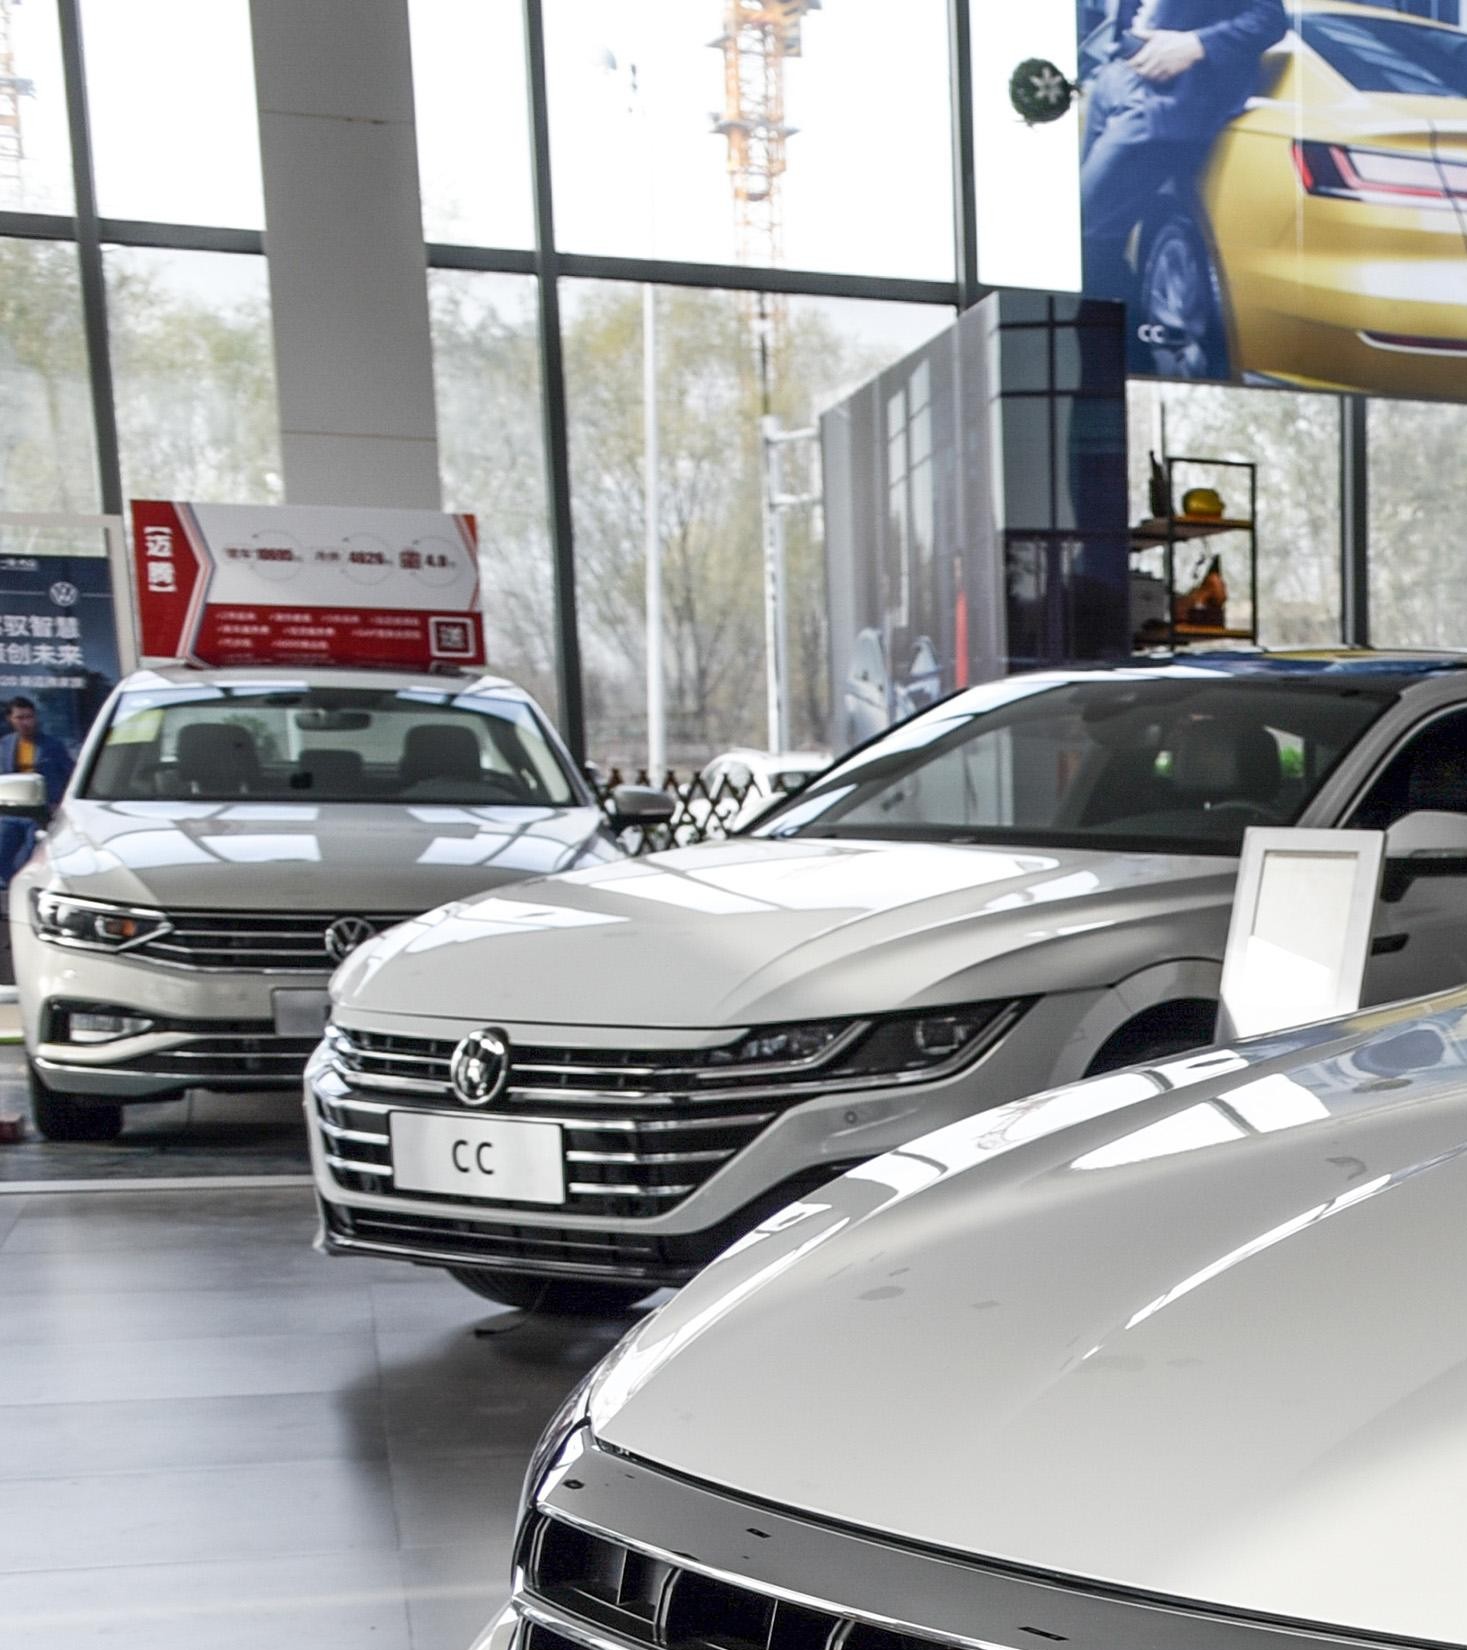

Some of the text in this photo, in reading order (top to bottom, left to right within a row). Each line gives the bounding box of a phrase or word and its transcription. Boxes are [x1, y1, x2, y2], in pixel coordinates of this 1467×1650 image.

[1137, 324, 1165, 344] CC
[0, 615, 80, 639] 驭智慧
[452, 1139, 495, 1175] CC
